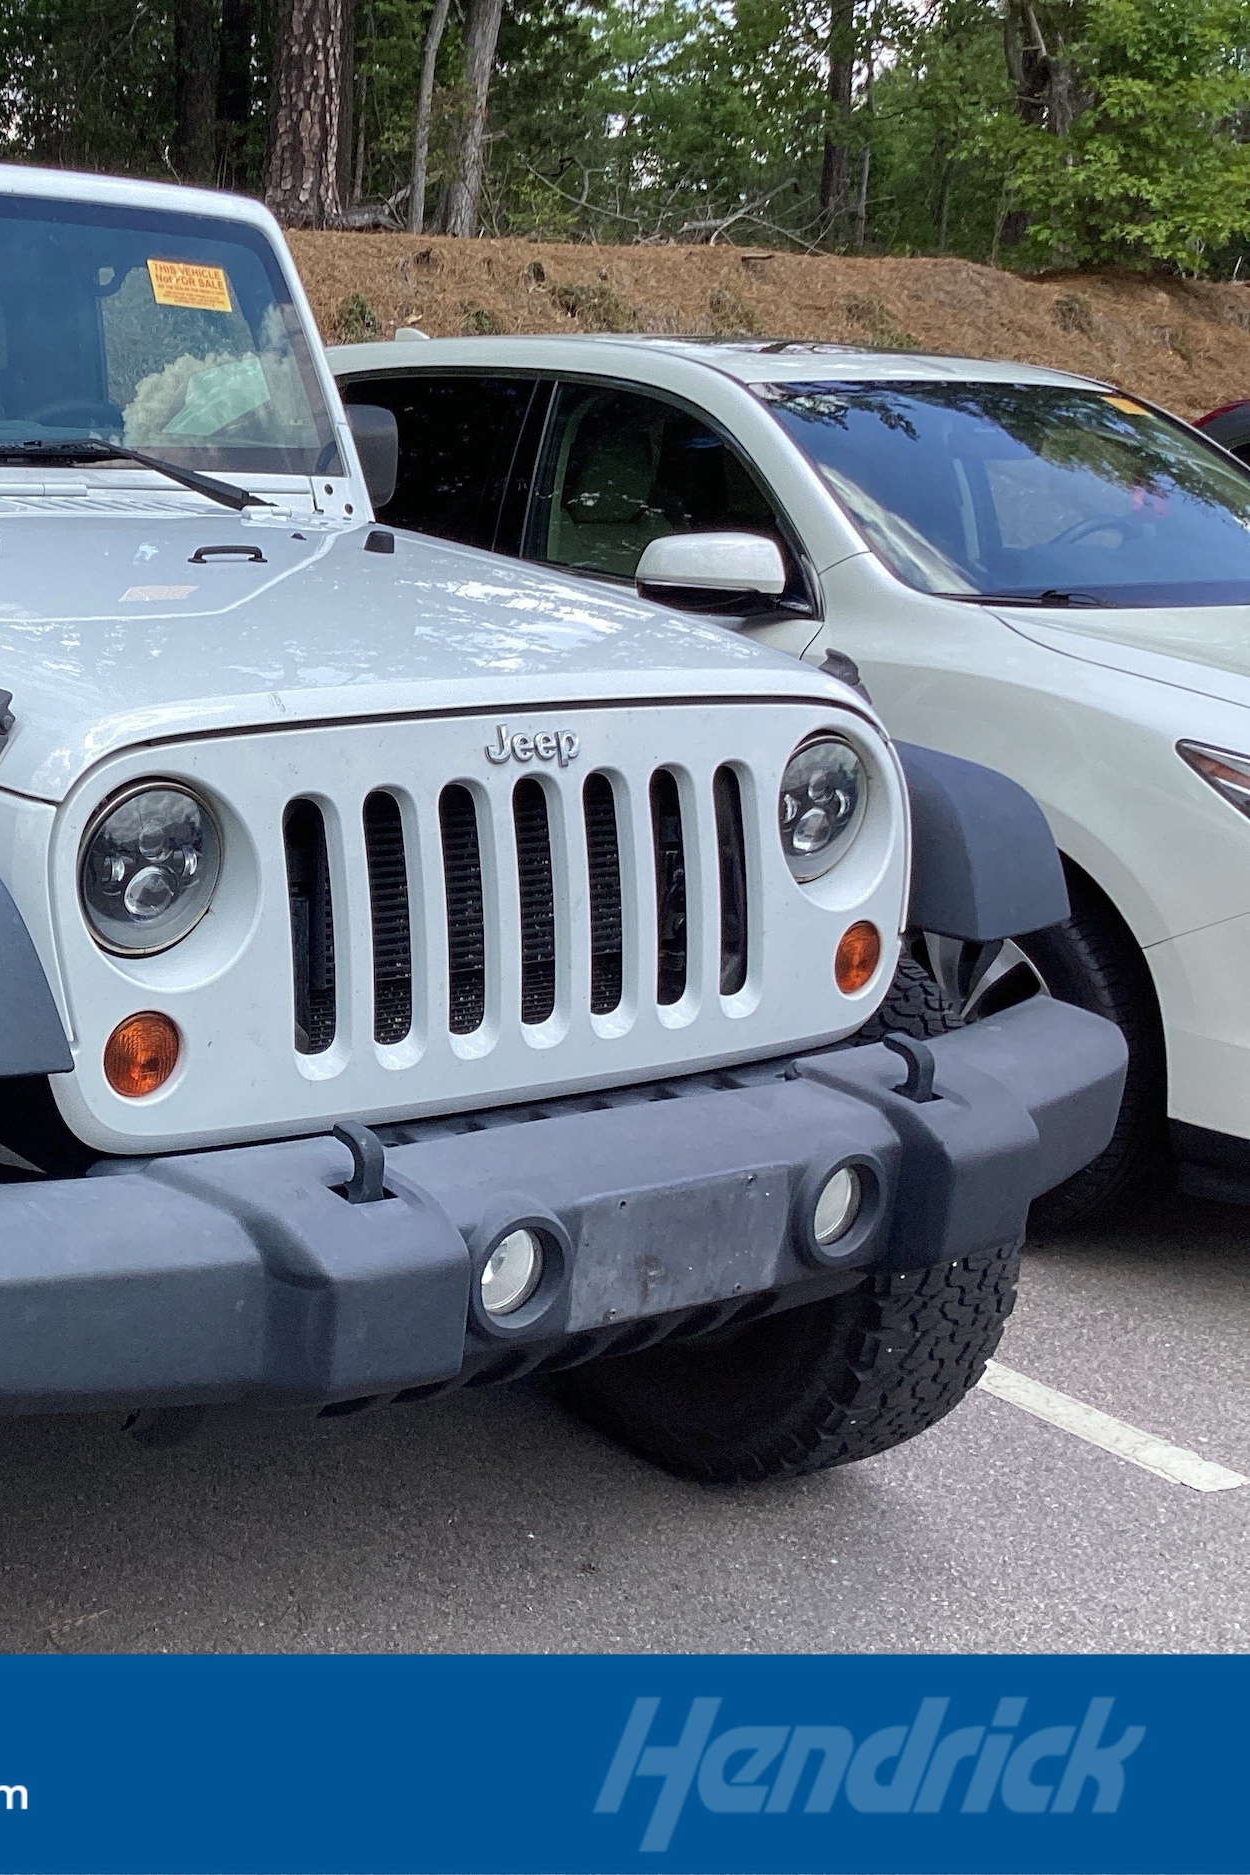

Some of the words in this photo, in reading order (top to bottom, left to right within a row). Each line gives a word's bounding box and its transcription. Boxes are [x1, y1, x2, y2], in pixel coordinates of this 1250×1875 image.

[153, 263, 176, 275] THIS
[178, 264, 221, 280] VEHICLE
[175, 276, 196, 287] FOR
[199, 279, 224, 290] SALE
[484, 723, 580, 767] Jeep
